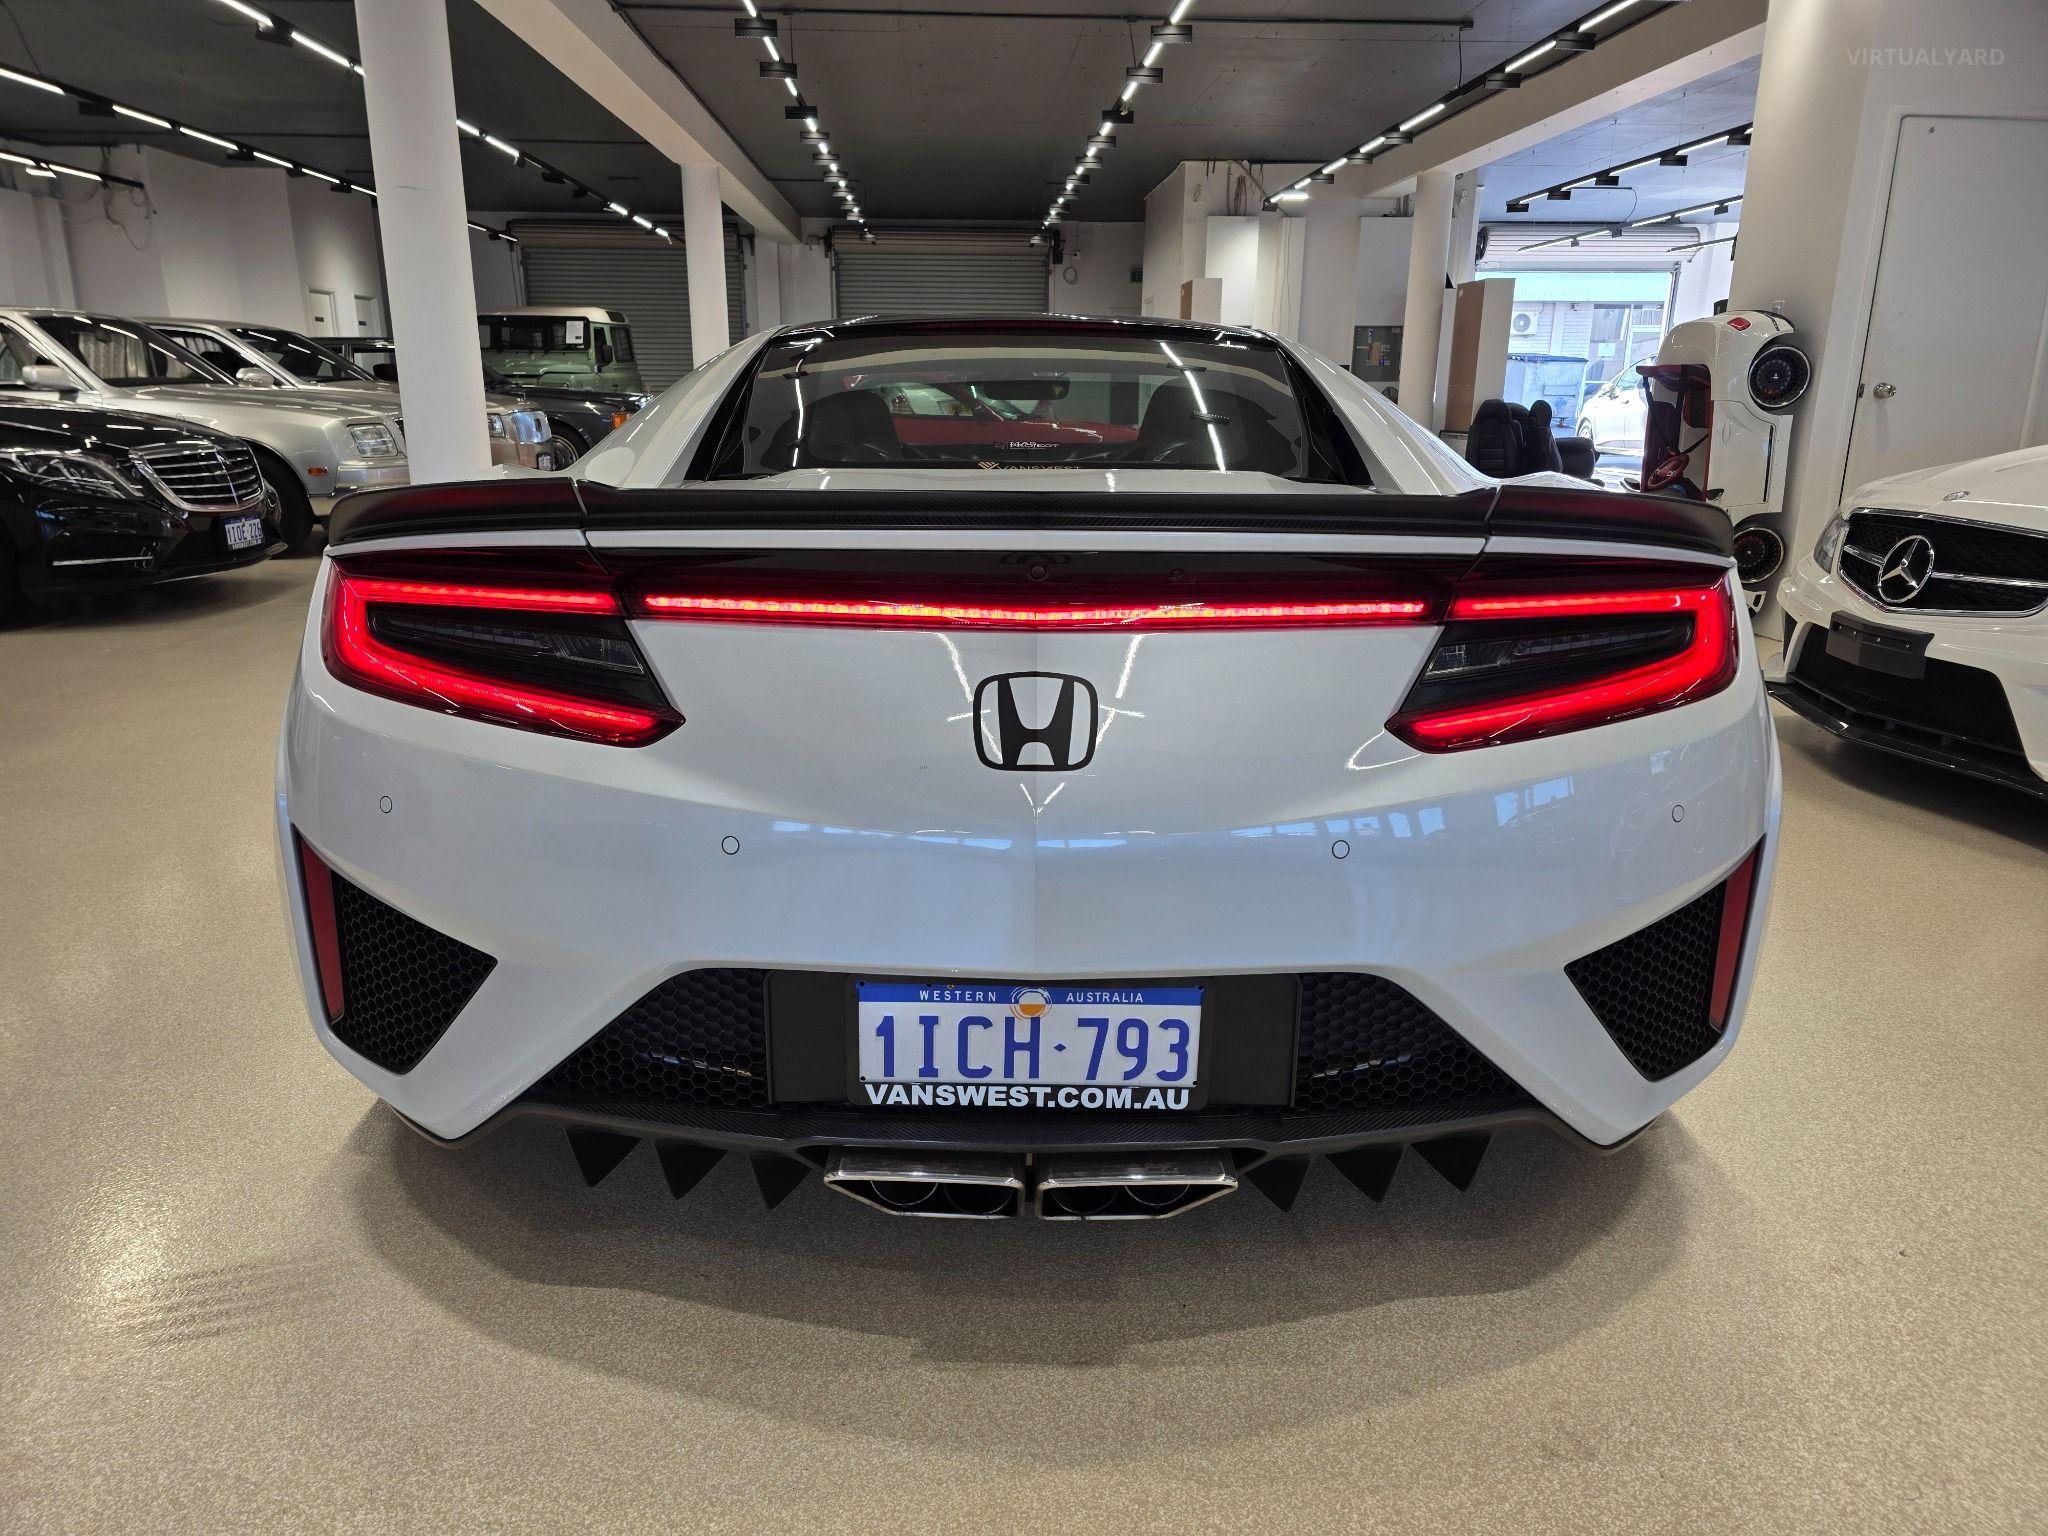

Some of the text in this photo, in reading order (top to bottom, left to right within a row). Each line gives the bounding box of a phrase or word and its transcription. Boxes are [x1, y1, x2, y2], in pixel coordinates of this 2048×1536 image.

[919, 990, 1144, 1004] WESTERN AUSTRALIA
[864, 1084, 1189, 1110] VANSWEST.COM.AU
